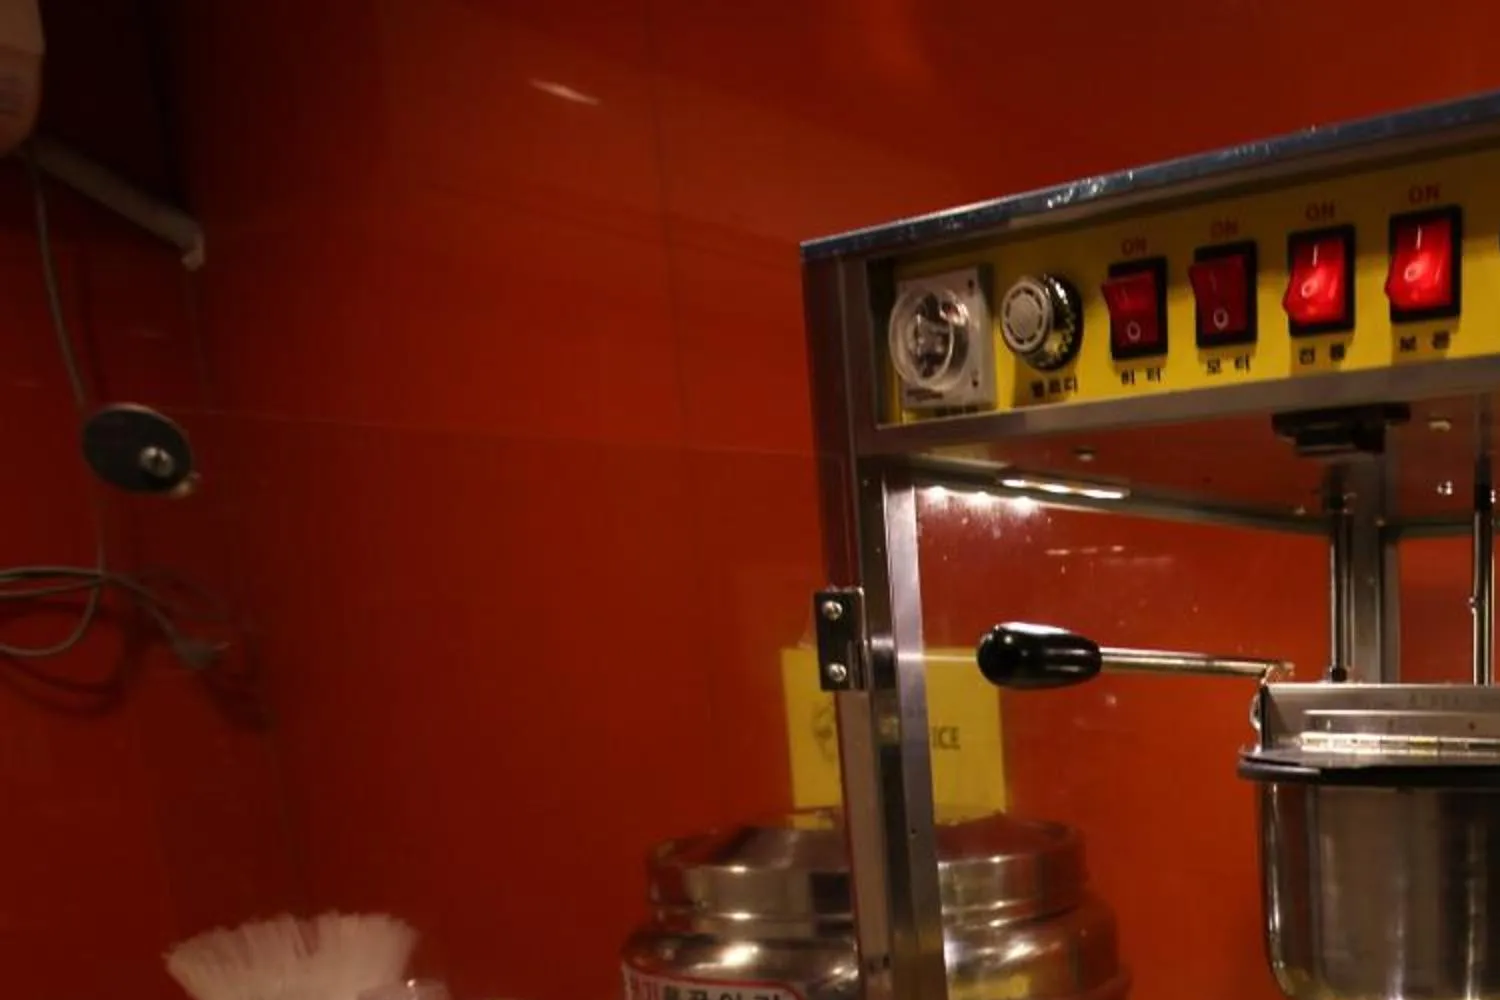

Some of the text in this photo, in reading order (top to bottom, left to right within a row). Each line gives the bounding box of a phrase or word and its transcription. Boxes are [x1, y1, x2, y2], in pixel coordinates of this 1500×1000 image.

[1409, 182, 1441, 204] ON
[1305, 199, 1335, 220] ON
[1121, 236, 1147, 255] ON
